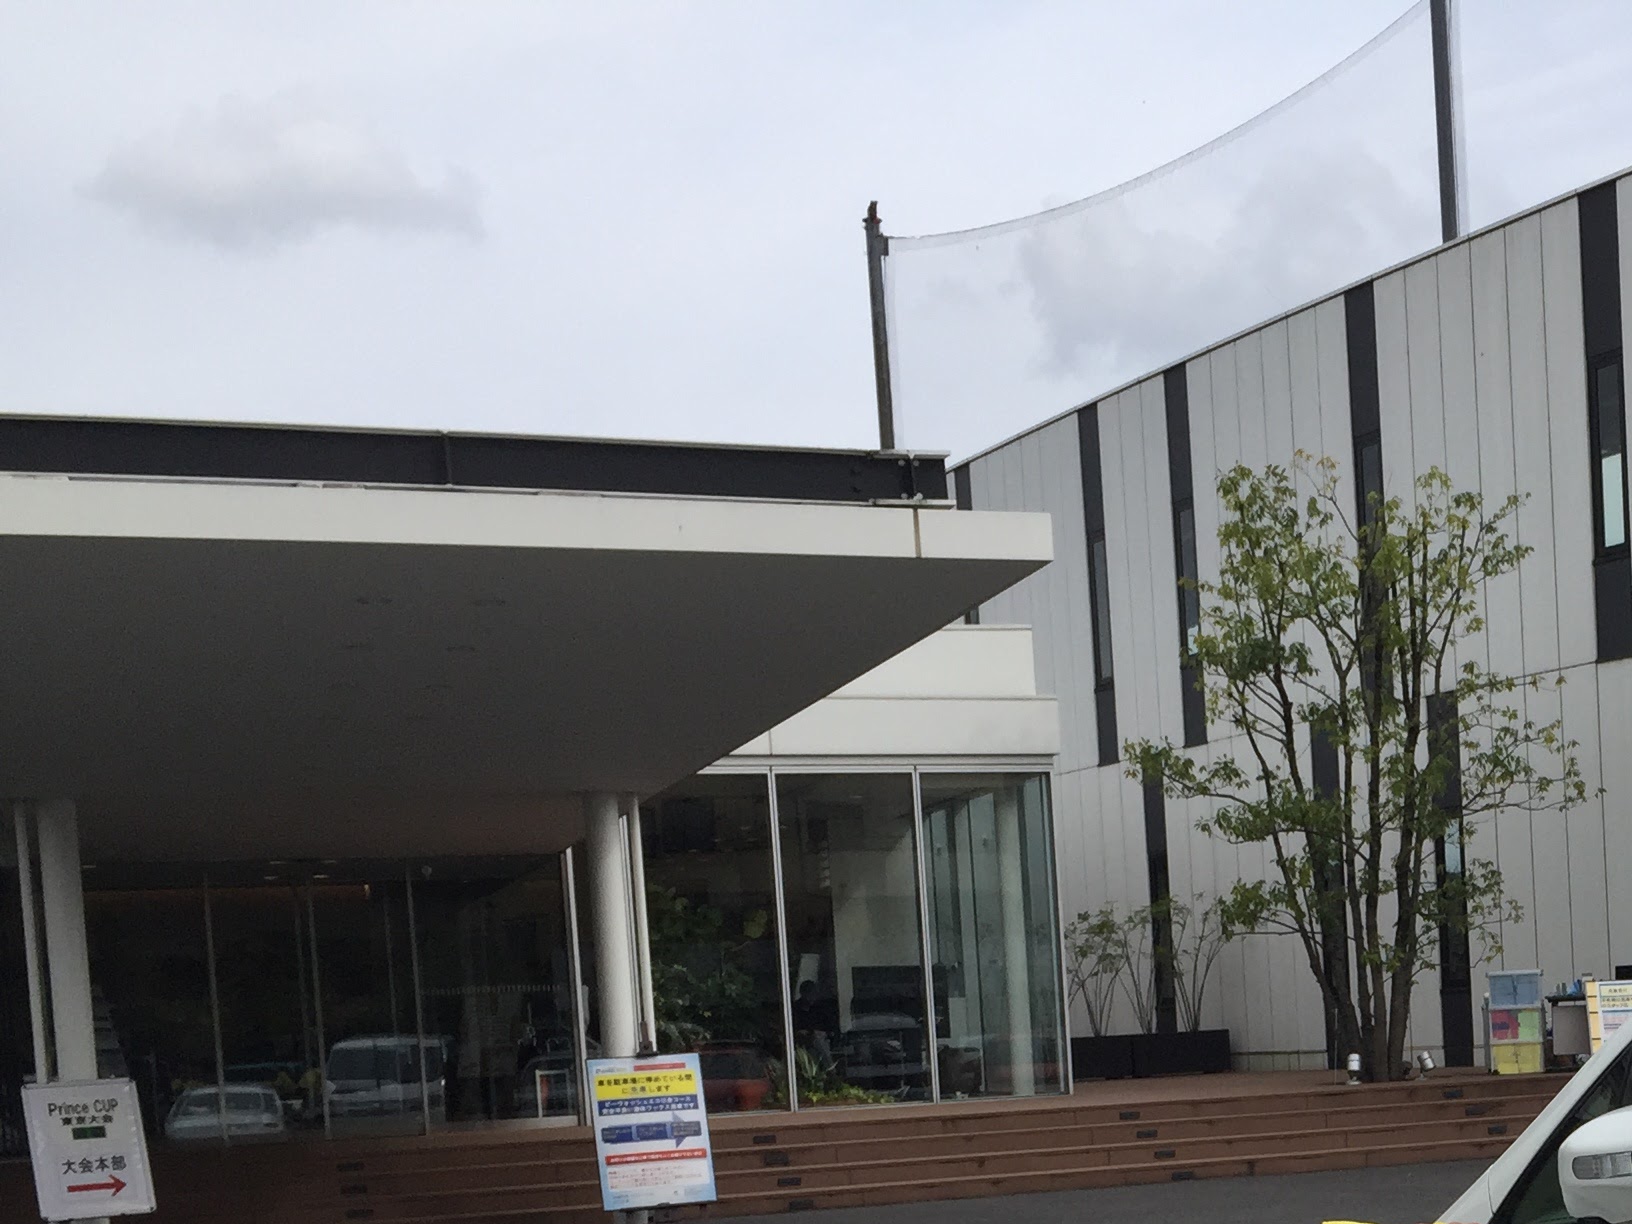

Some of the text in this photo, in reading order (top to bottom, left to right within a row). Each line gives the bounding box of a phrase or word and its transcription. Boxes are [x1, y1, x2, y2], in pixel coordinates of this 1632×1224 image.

[48, 1098, 118, 1117] Prince CUP
[62, 1155, 126, 1174] 大会本部
